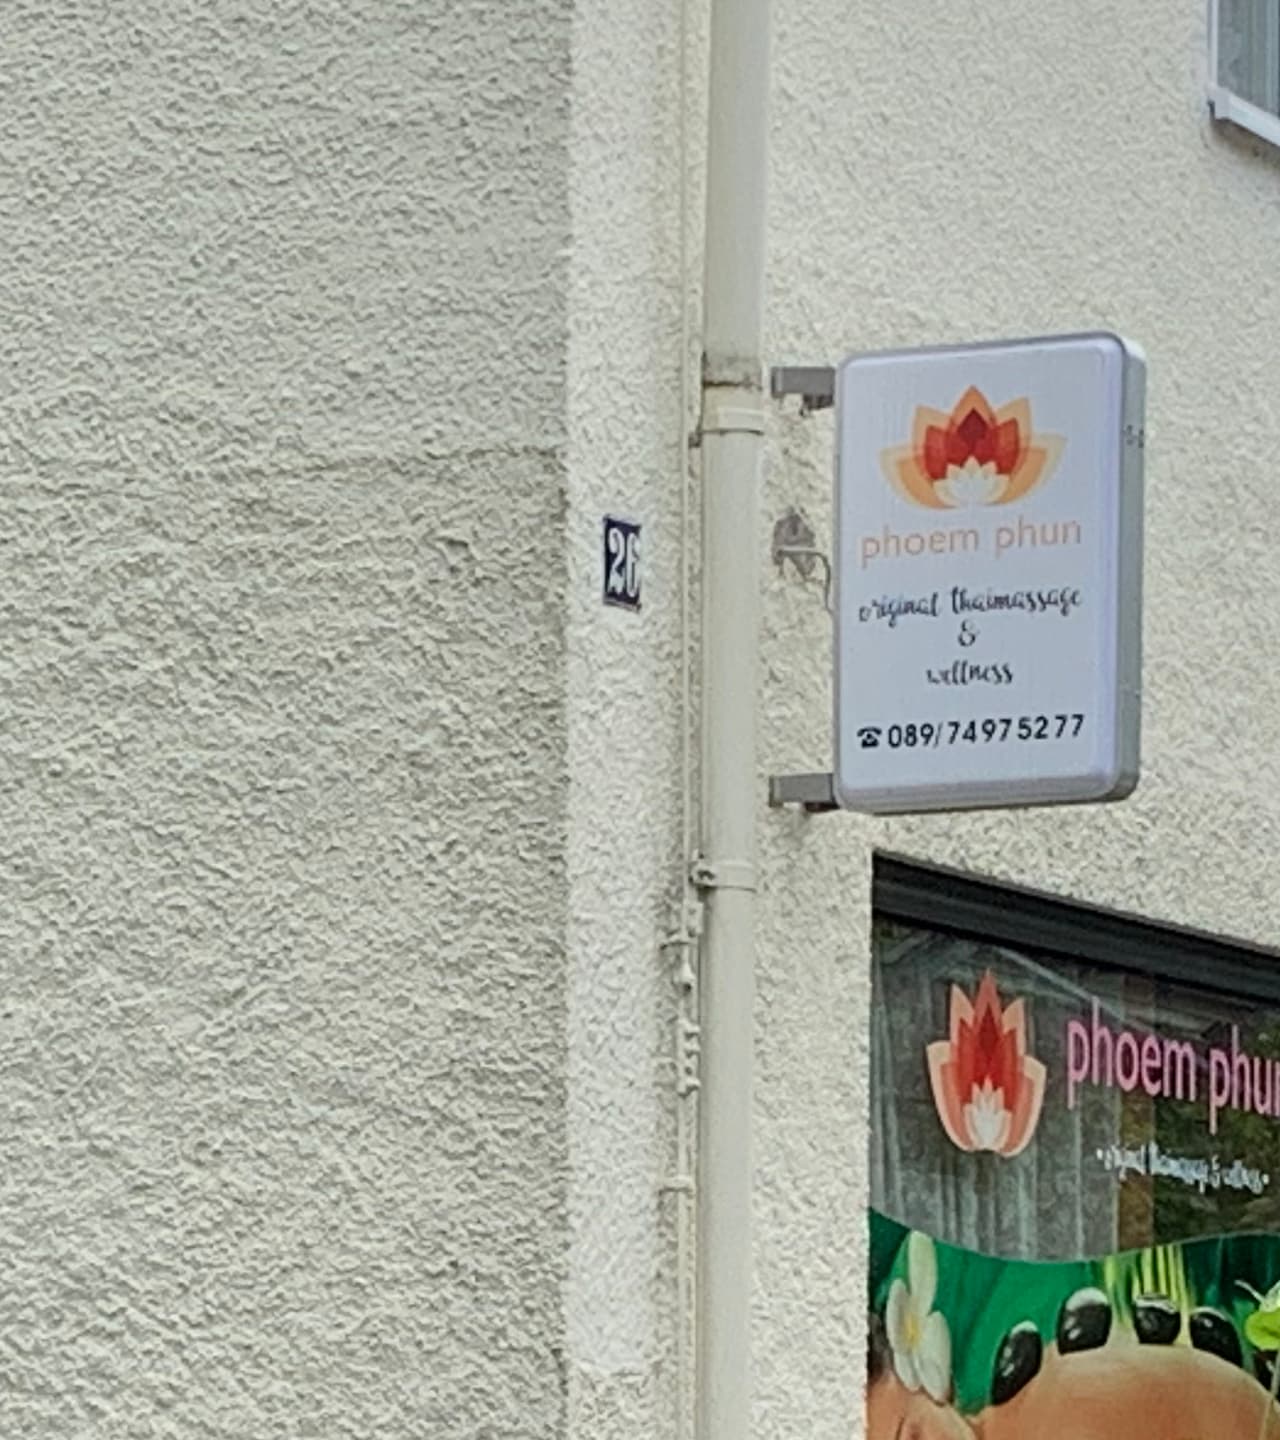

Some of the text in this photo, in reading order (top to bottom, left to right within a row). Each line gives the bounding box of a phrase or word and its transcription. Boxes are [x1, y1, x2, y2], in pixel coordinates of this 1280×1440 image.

[860, 515, 1082, 569] phoem phun
[858, 586, 1081, 629] original thaimassage
[957, 618, 980, 648] &
[925, 659, 1014, 686] wellness
[887, 713, 1085, 749] 089/74975277
[1067, 996, 1197, 1110] phoem
